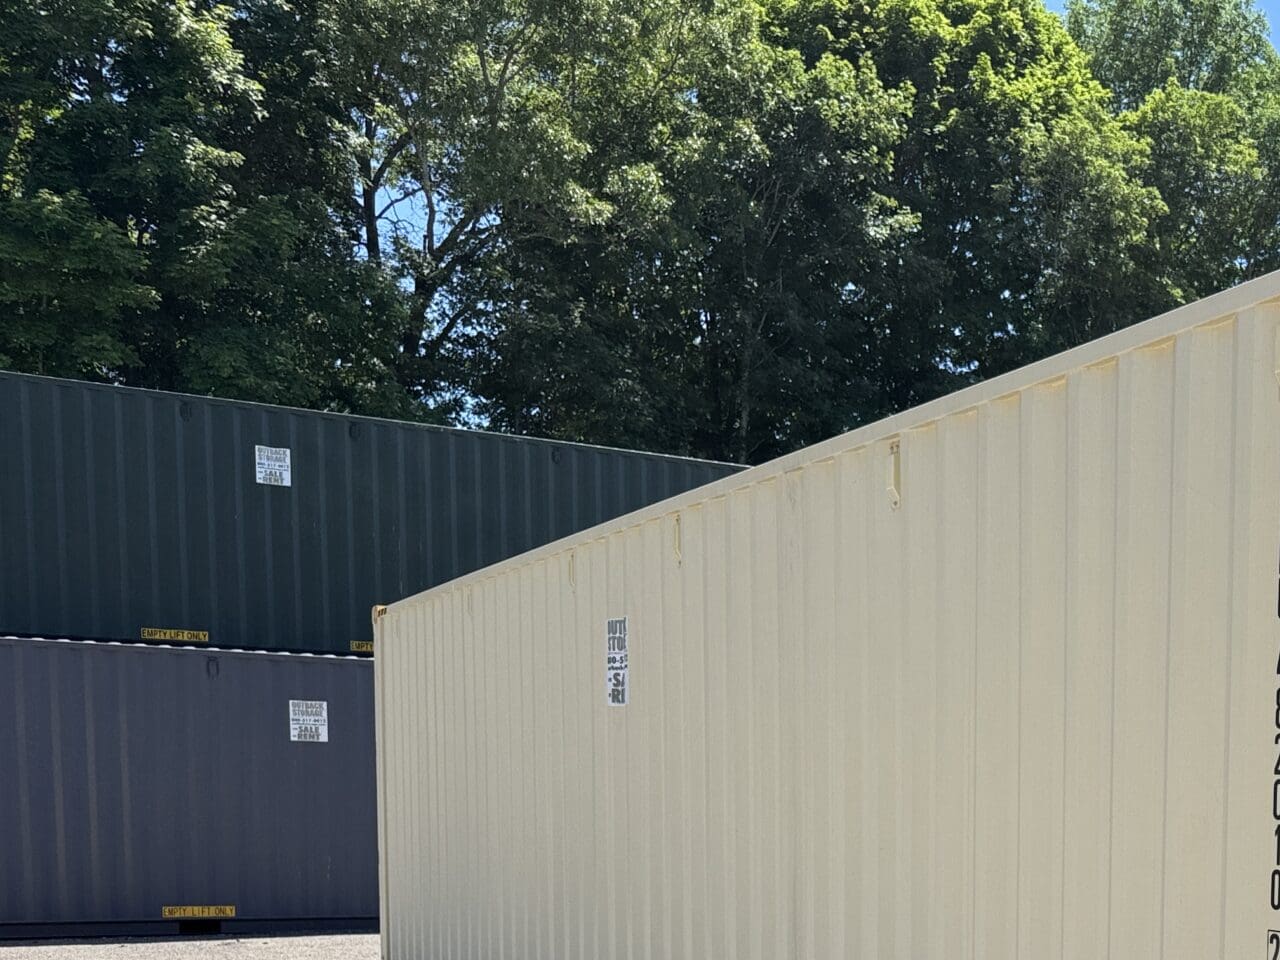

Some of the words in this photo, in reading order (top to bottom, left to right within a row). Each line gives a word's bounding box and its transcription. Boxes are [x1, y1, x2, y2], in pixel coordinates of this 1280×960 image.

[142, 628, 168, 638] EMPTY
[170, 630, 185, 640] LIFT
[186, 631, 208, 640] ONLY
[163, 906, 187, 916] EMPTY
[191, 906, 211, 916] LIFT
[214, 906, 234, 916] ONLY
